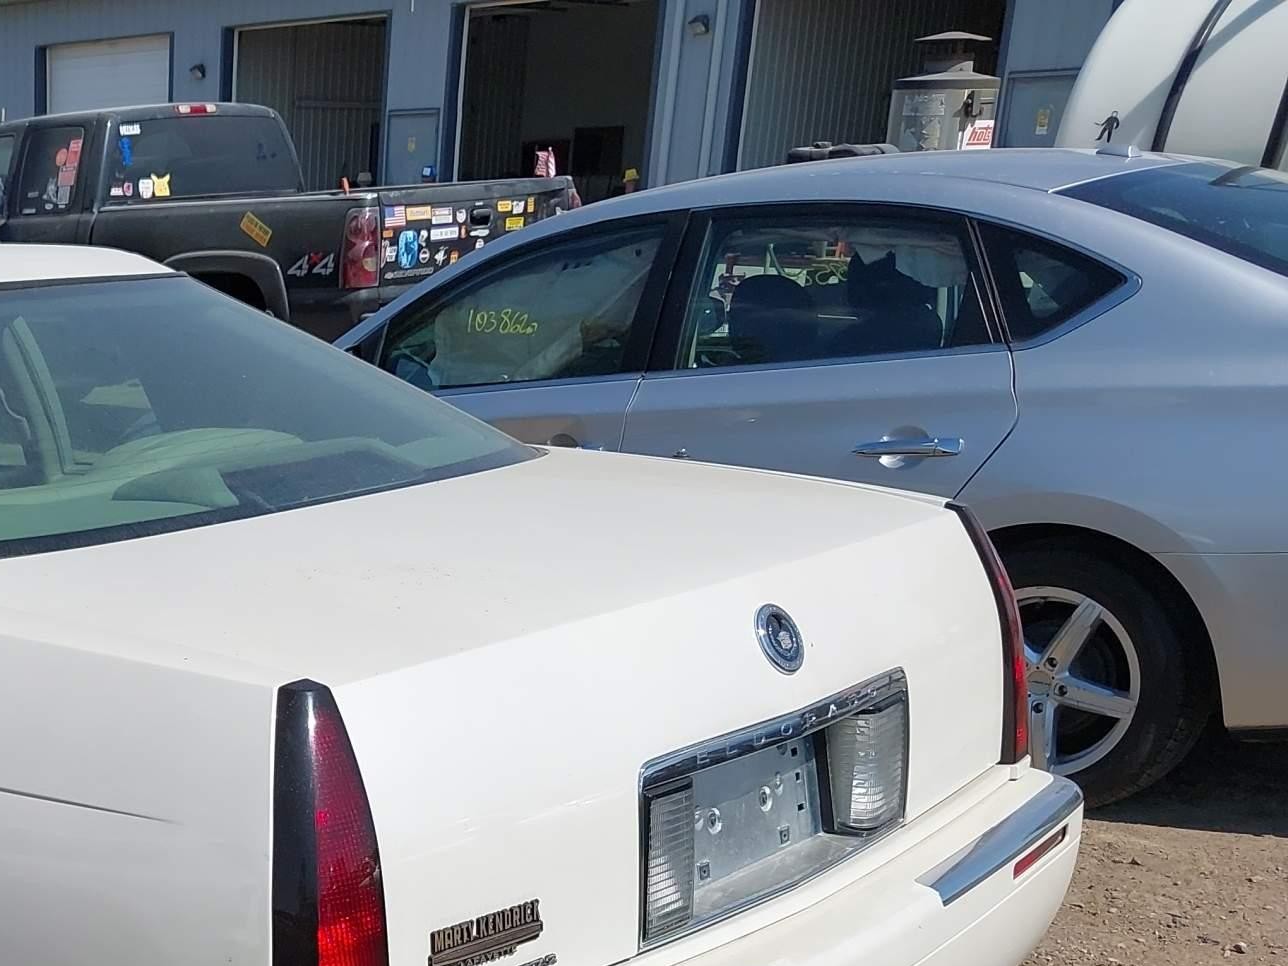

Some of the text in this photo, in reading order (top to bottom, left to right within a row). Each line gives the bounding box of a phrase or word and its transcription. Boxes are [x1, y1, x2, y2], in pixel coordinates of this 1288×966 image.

[696, 686, 878, 765] ELDORADO
[431, 899, 541, 953] MARTY KENDRICK
